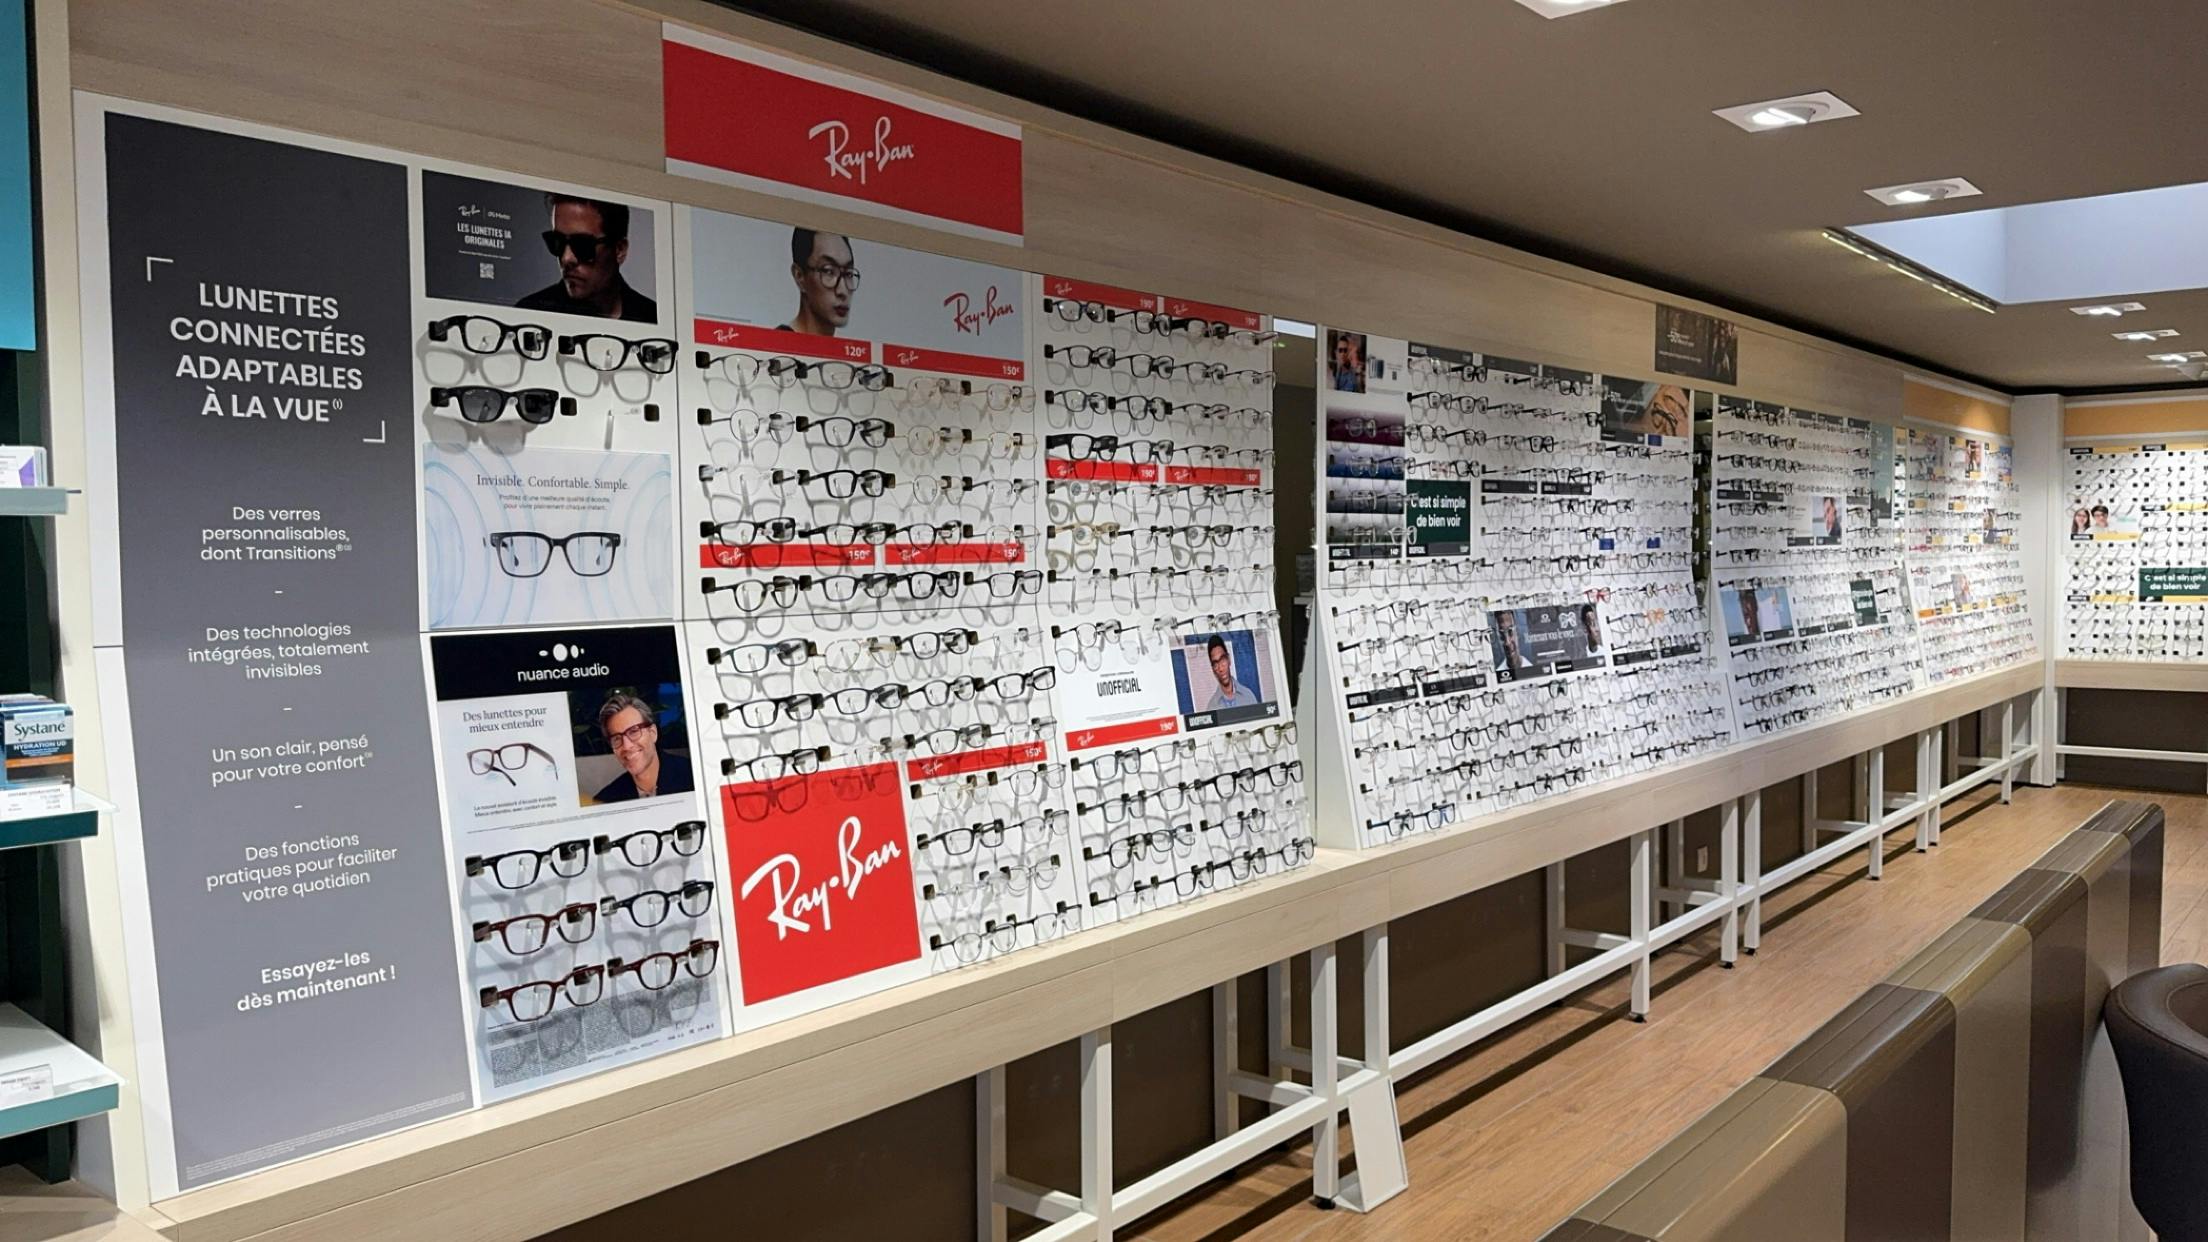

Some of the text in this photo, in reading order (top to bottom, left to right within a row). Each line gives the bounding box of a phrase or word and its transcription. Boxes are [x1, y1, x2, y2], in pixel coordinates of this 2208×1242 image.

[457, 222, 470, 232] LES
[471, 224, 503, 239] LUNETTES
[464, 235, 505, 249] ORIGINALES
[200, 282, 339, 320] LUNETTES
[170, 316, 366, 357] CONNECTÉES
[175, 354, 364, 391] ADAPTABLES
[201, 385, 224, 417] À
[231, 394, 267, 419] LA
[477, 474, 630, 493] Invisible. Confortable. Simple.
[1432, 494, 1440, 508] si
[1440, 494, 1467, 512] simple
[232, 506, 321, 521] Des verres
[1416, 513, 1462, 527] de bien voir
[202, 526, 350, 544] personnalisables,
[200, 546, 242, 561] dont
[2149, 582, 2201, 591] de bien voir
[206, 622, 351, 642] Des technologies
[188, 641, 370, 665] intégrées, totalement
[245, 662, 322, 679] invisibles
[517, 663, 610, 682] nuance audio
[1096, 678, 1142, 697] UNOFFICIAL
[463, 706, 548, 723] Des lunettes pour
[14, 722, 66, 742] Systane
[469, 718, 545, 734] mieux entendre
[212, 734, 368, 763] Un son clair, pensé
[212, 766, 254, 787] pour
[257, 761, 302, 778] votre
[245, 834, 360, 861] Des fonctions
[206, 847, 398, 892] pratiques pour faciliter
[242, 871, 371, 903] votre quotidien
[261, 951, 371, 984] Essayez-les
[237, 992, 273, 1012] dès
[277, 967, 387, 1004] maintenant
